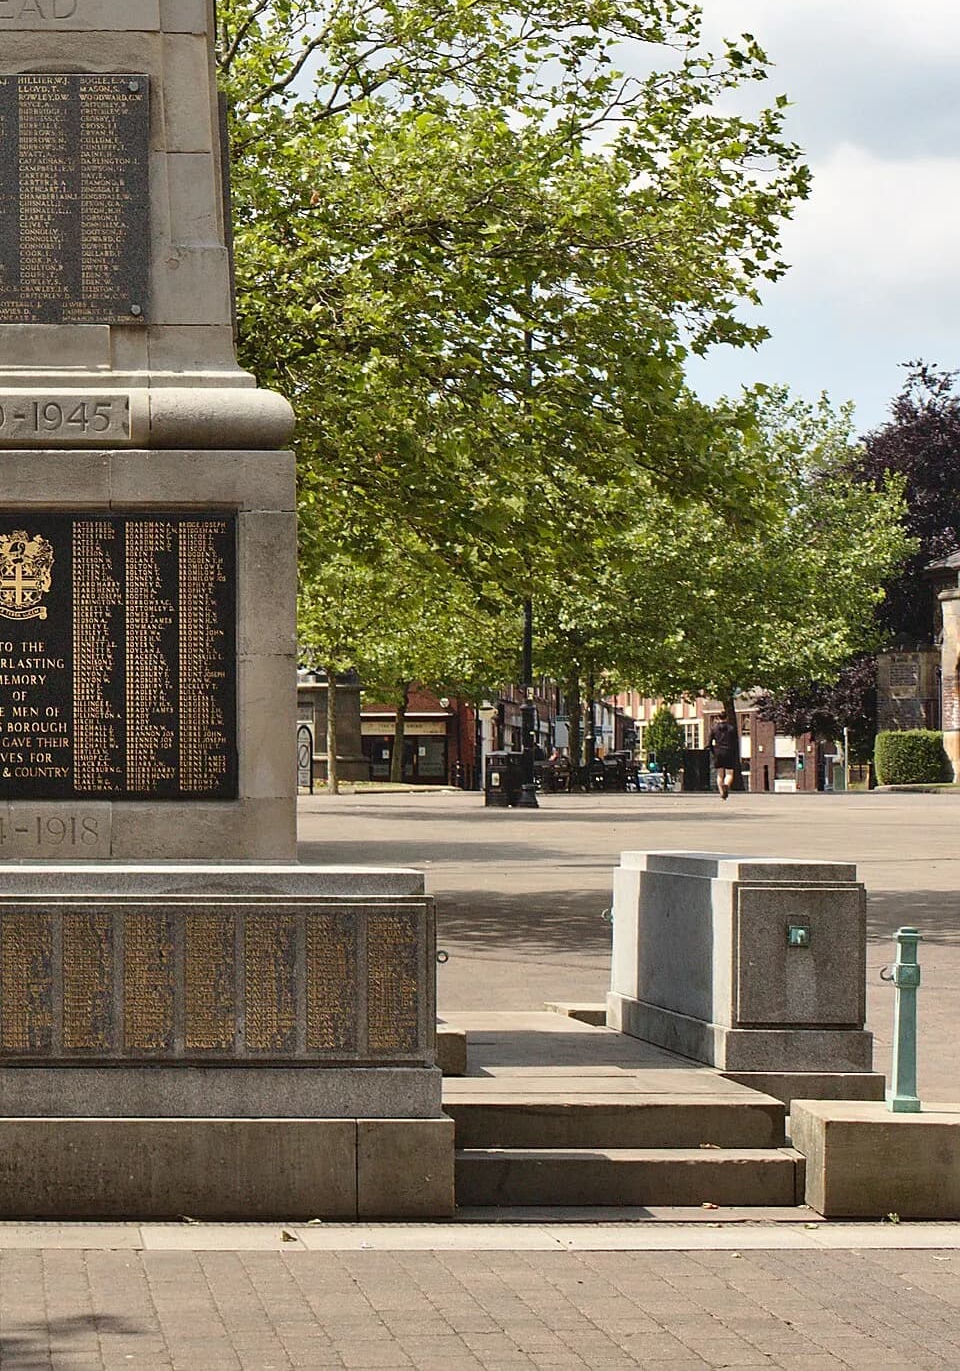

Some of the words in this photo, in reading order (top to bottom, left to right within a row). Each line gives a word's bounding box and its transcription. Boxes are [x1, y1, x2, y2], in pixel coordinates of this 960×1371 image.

[21, 641, 45, 653] THE
[12, 690, 28, 702] OF
[12, 706, 39, 717] MEN
[45, 706, 61, 717] OF
[7, 721, 67, 733] BOROUGH
[2, 737, 32, 748] GAVE
[36, 737, 70, 748] THEIR
[30, 752, 53, 763] FOR
[2, 766, 12, 778] &
[14, 766, 70, 778] COUNTRY
